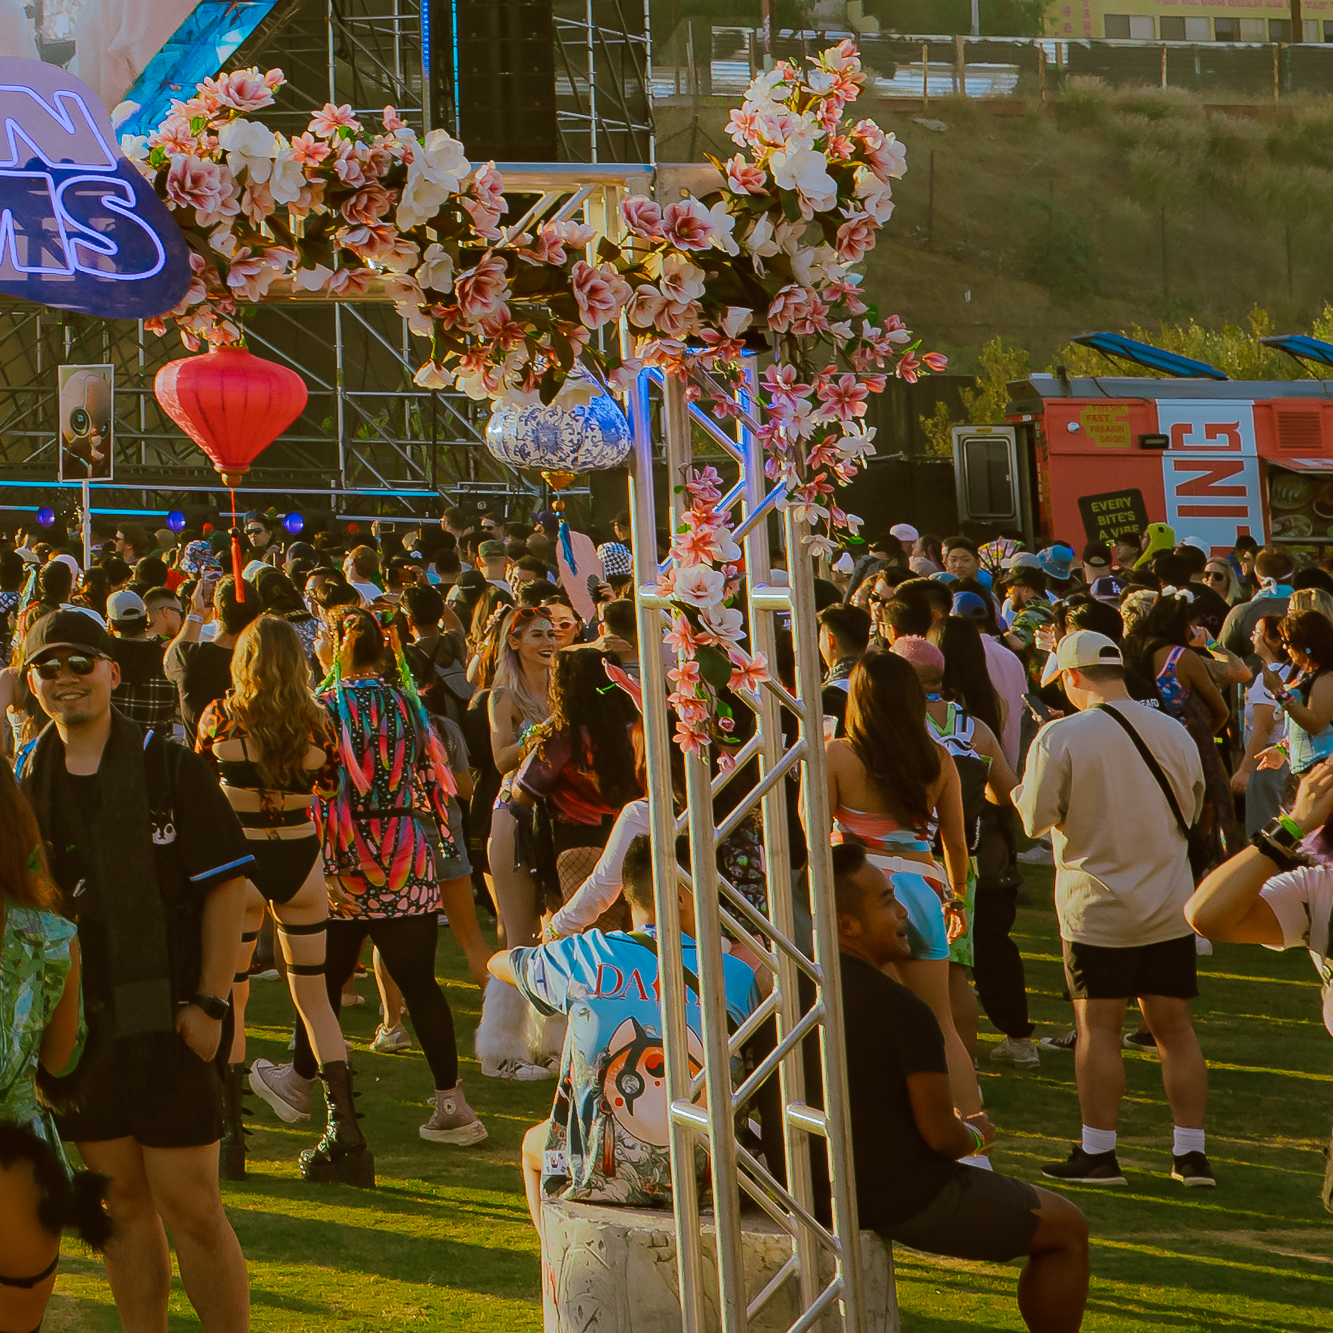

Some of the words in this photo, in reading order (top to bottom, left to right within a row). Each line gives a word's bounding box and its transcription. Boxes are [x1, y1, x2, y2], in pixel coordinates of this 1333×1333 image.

[1090, 497, 1133, 513] EVERY
[1097, 511, 1137, 526] BITE'S
[1099, 529, 1109, 541] A
